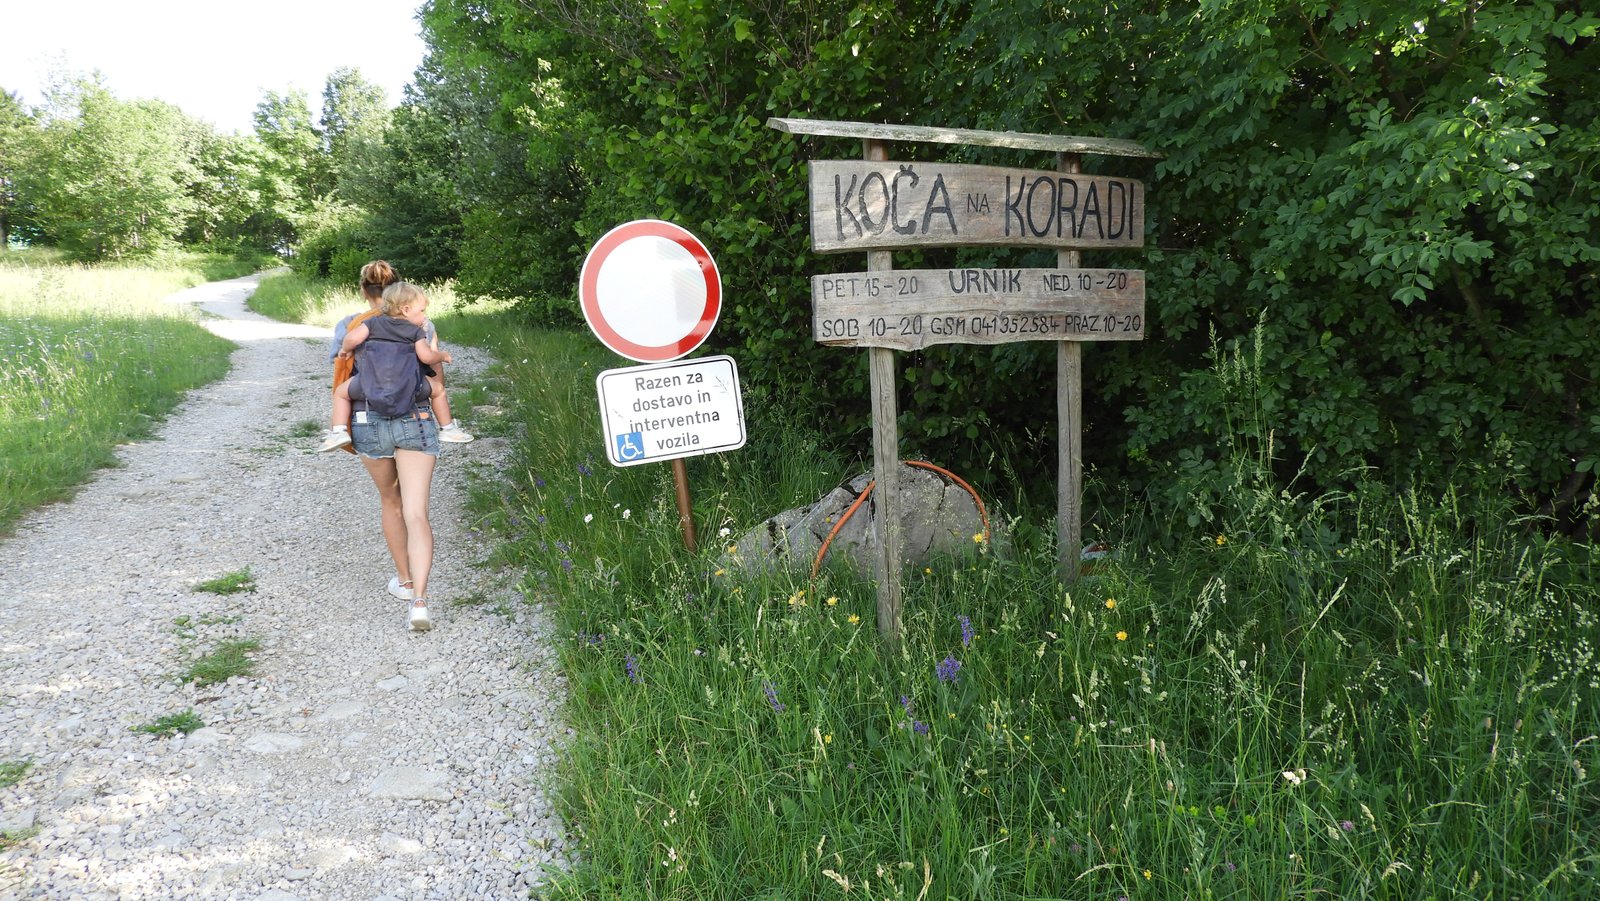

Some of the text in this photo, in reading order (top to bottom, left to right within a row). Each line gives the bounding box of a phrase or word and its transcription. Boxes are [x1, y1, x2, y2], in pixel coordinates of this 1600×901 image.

[834, 164, 1135, 241] KOČA NA KORADI
[949, 269, 1022, 294] URNIK
[822, 318, 860, 338] SOB
[930, 316, 966, 336] GSM
[635, 372, 703, 391] Razen za
[632, 390, 711, 412] dostavo in
[630, 410, 720, 433] interventna
[656, 433, 700, 450] vozila
